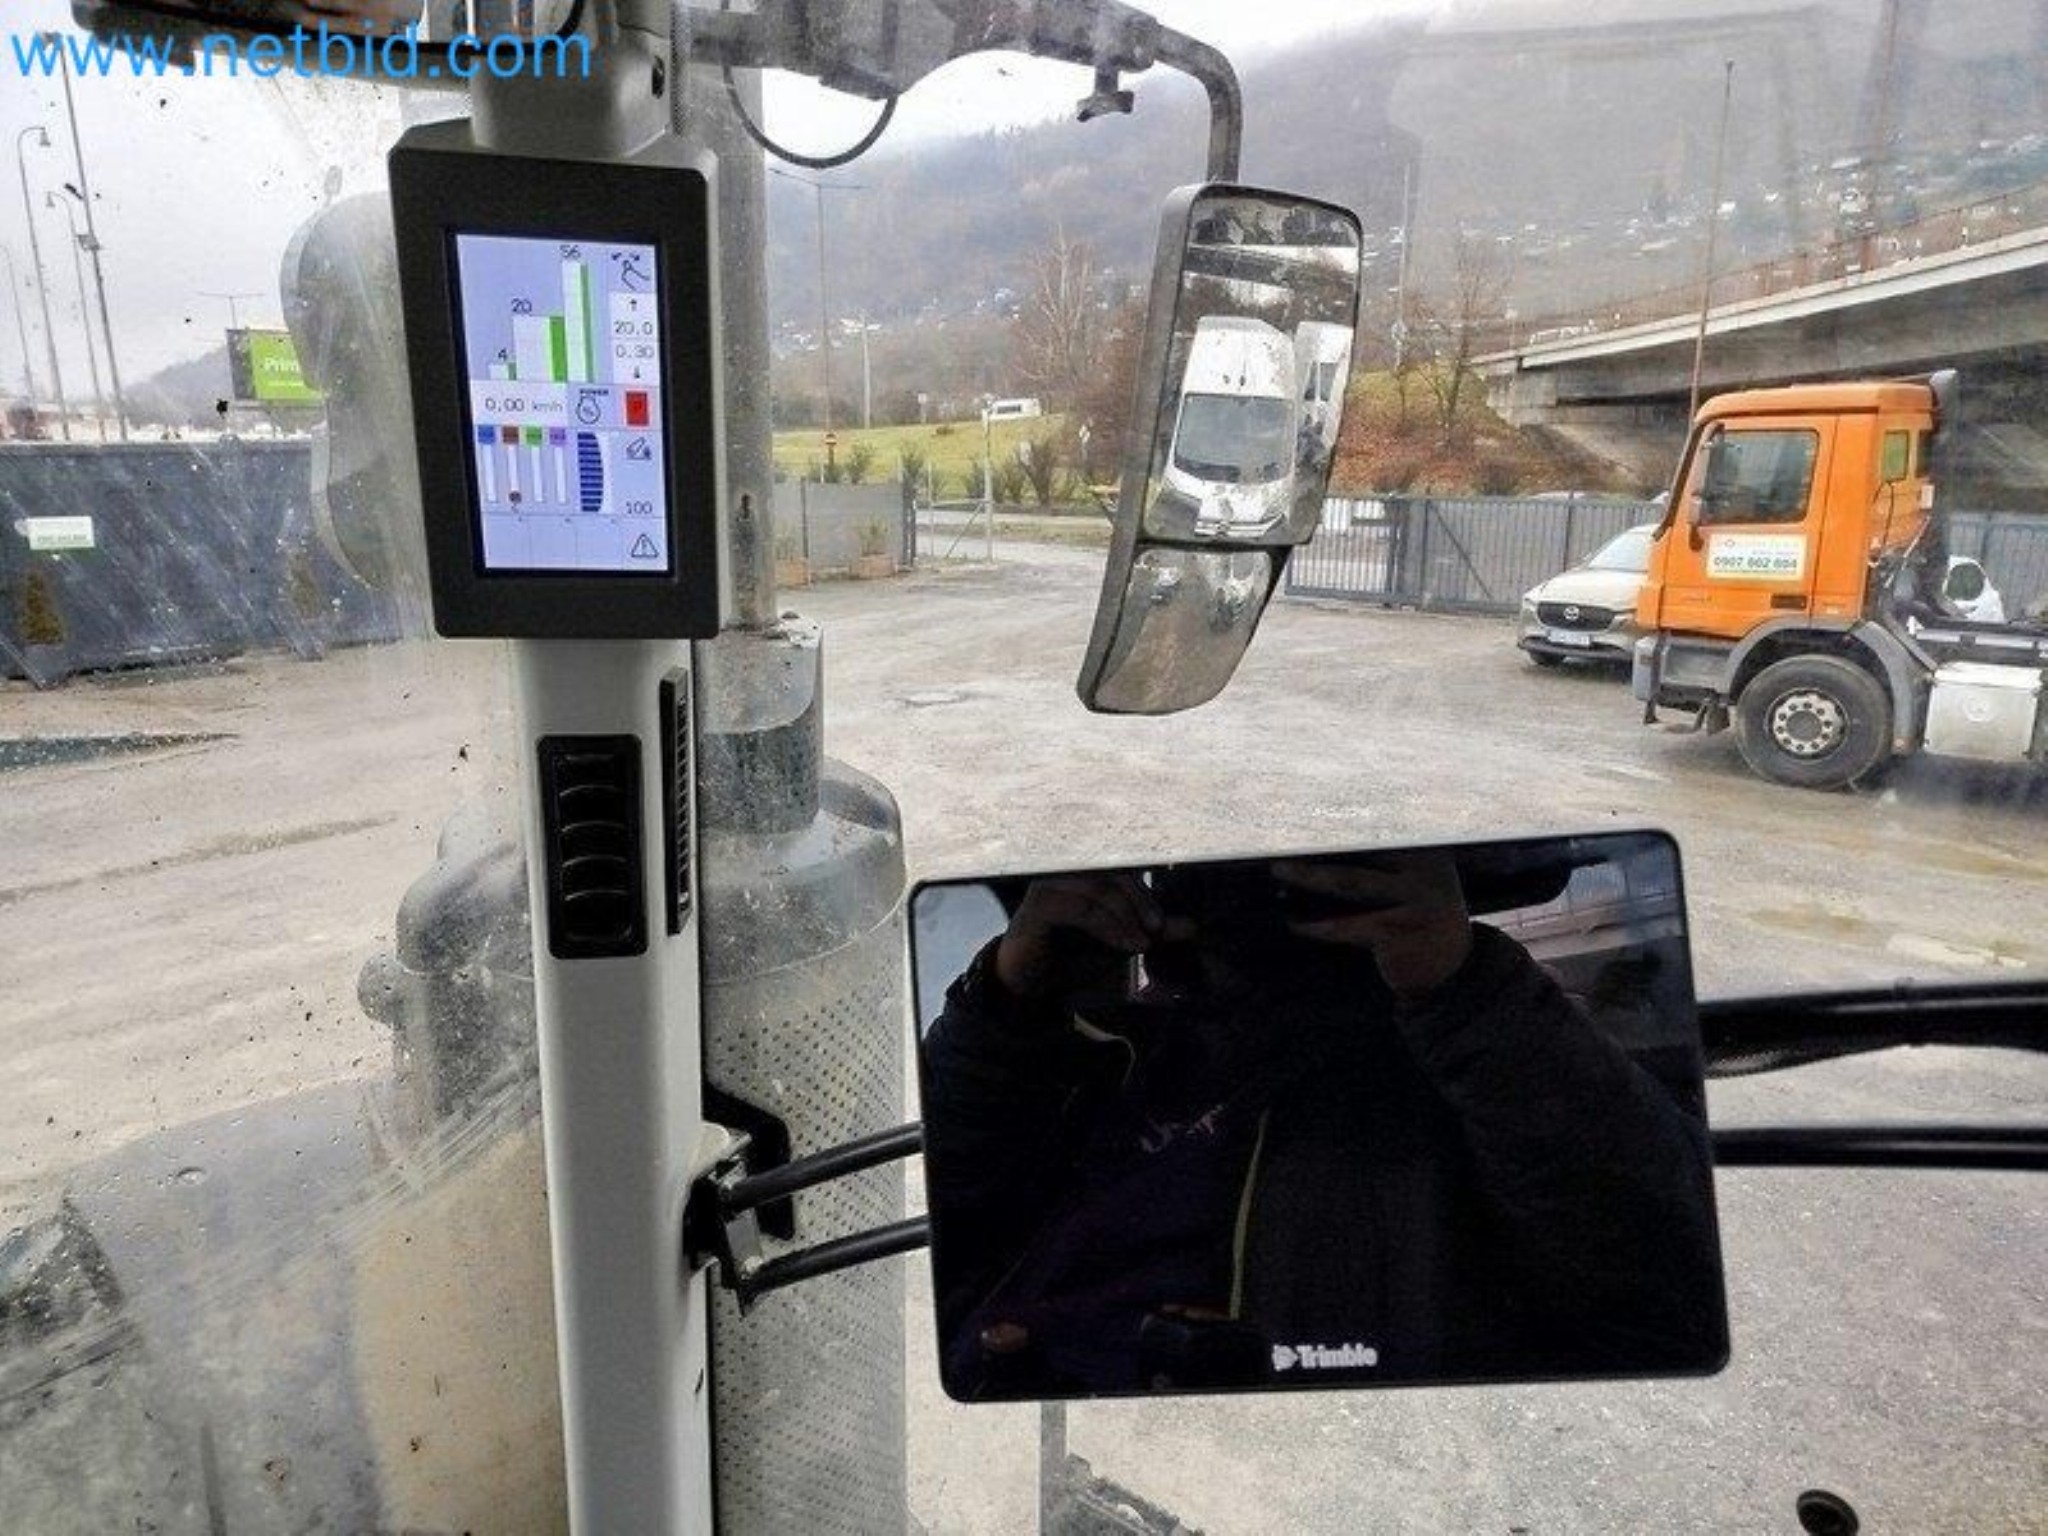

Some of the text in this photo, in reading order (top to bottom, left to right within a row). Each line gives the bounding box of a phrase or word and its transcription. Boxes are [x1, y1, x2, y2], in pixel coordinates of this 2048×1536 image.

[560, 244, 580, 259] 56
[511, 298, 532, 314] 20
[613, 321, 653, 335] 20.0
[498, 348, 507, 361] 4
[626, 501, 653, 514] 100
[1296, 1343, 1378, 1369] Trimble
